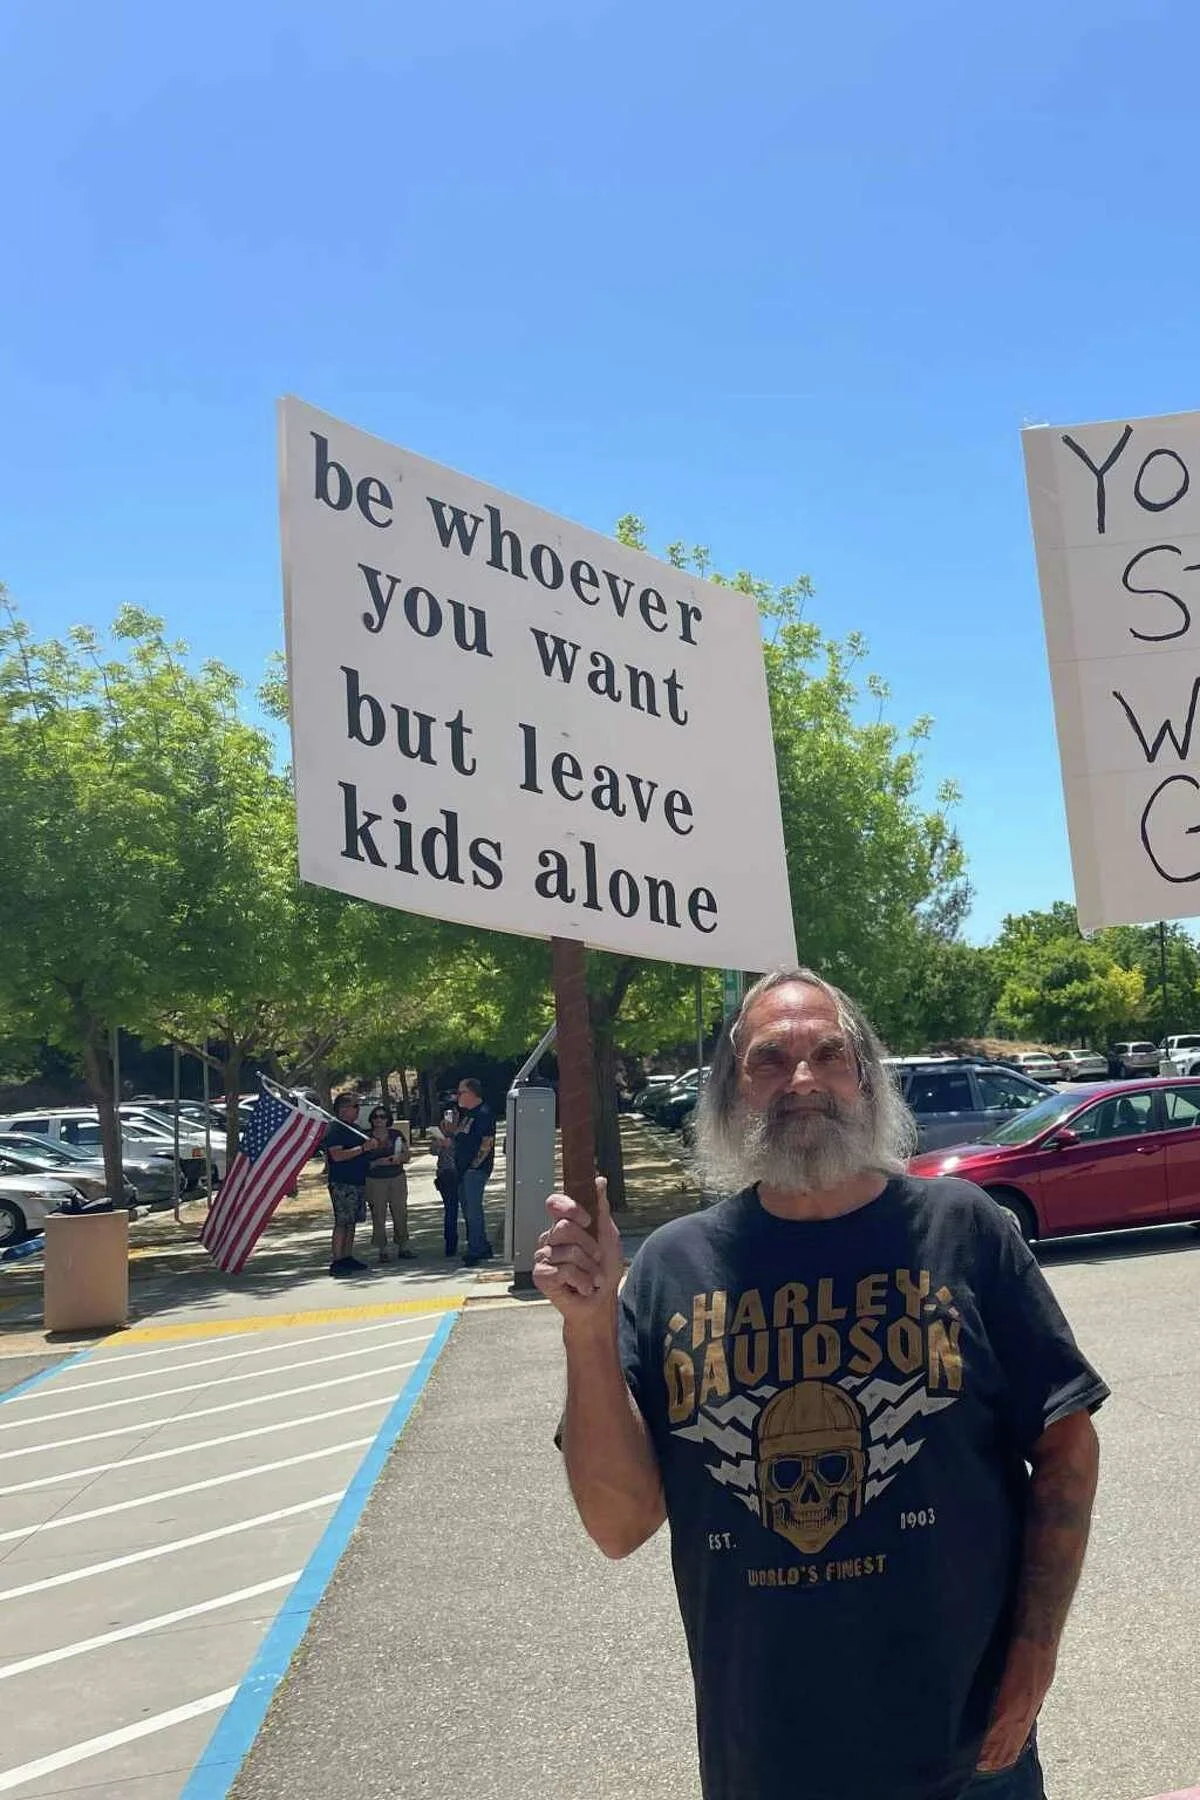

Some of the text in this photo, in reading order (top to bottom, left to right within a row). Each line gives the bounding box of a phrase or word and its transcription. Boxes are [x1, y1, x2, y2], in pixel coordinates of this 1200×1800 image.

[310, 431, 703, 646] be whoever
[357, 562, 689, 727] you want
[339, 665, 694, 836] but leave
[337, 780, 718, 934] kids alone
[692, 1268, 931, 1350] HARLEY
[707, 1530, 737, 1551] EST.
[747, 1553, 887, 1587] WORLD'S FINEST
[900, 1507, 936, 1530] 1903
